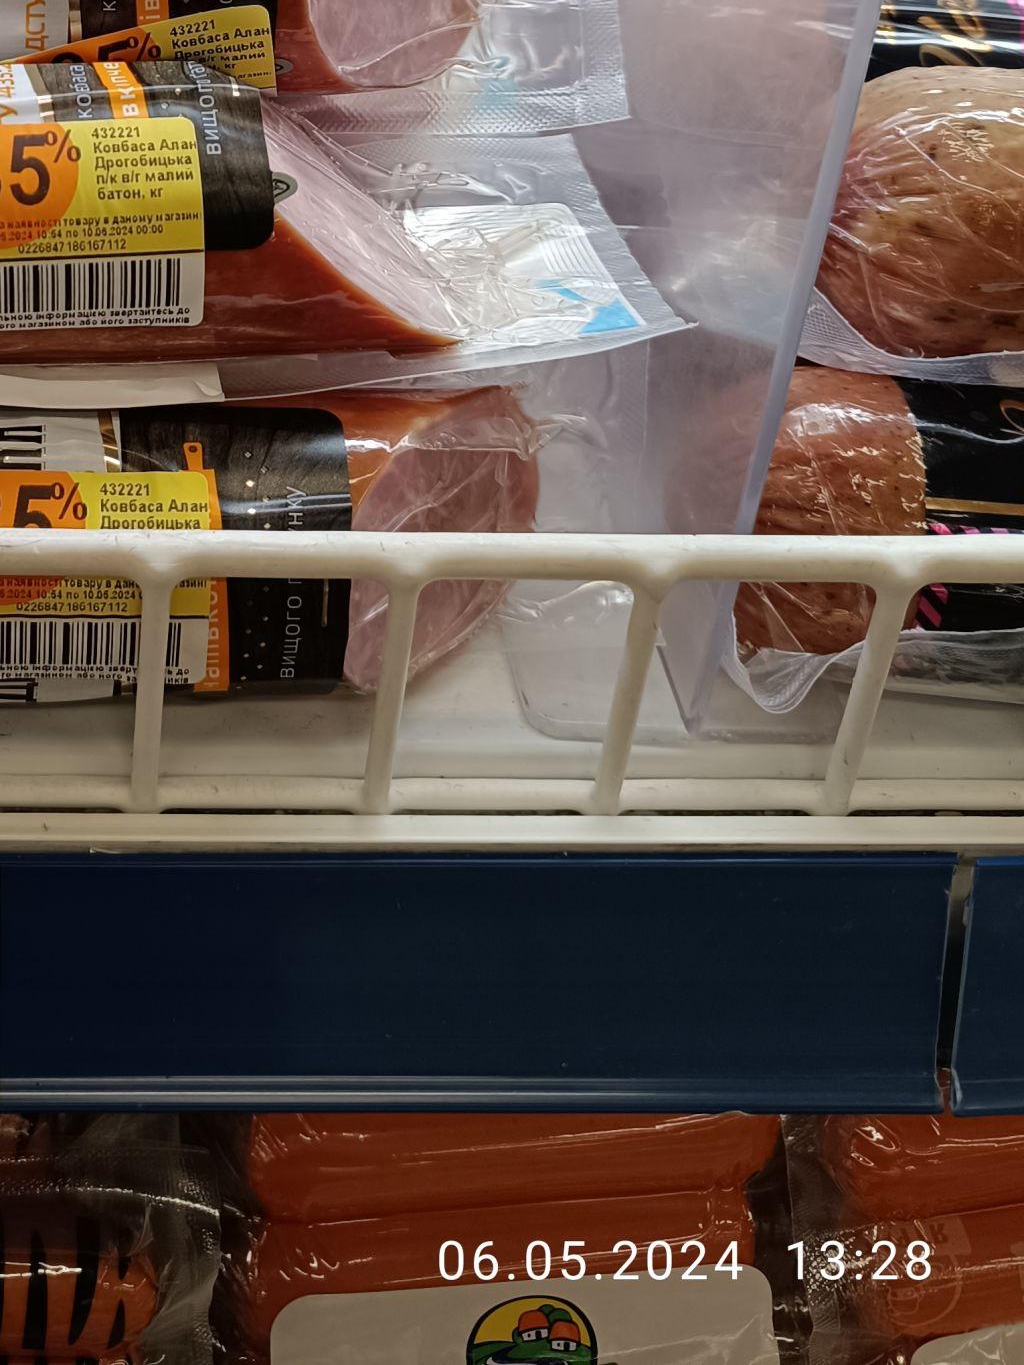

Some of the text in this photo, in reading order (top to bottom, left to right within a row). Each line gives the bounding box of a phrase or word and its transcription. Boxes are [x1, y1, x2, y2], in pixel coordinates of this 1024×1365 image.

[170, 19, 215, 37] 432221
[172, 32, 230, 49] Ковбаса
[234, 27, 270, 38] Алан
[174, 41, 264, 61] Дрогобицька
[91, 127, 140, 138] 432221
[94, 138, 196, 154] Ковбаса Алан
[95, 155, 192, 171] Дрогобицька
[96, 168, 194, 185] п/к в/г малий
[98, 188, 164, 201] батон, кг
[136, 225, 163, 235] 00:00
[100, 483, 150, 496] 432221
[100, 498, 208, 513] Ковбаса Алан
[100, 516, 201, 530] Дрогобицька
[16, 602, 128, 613] 0226847186167112
[280, 595, 303, 679] вищого
